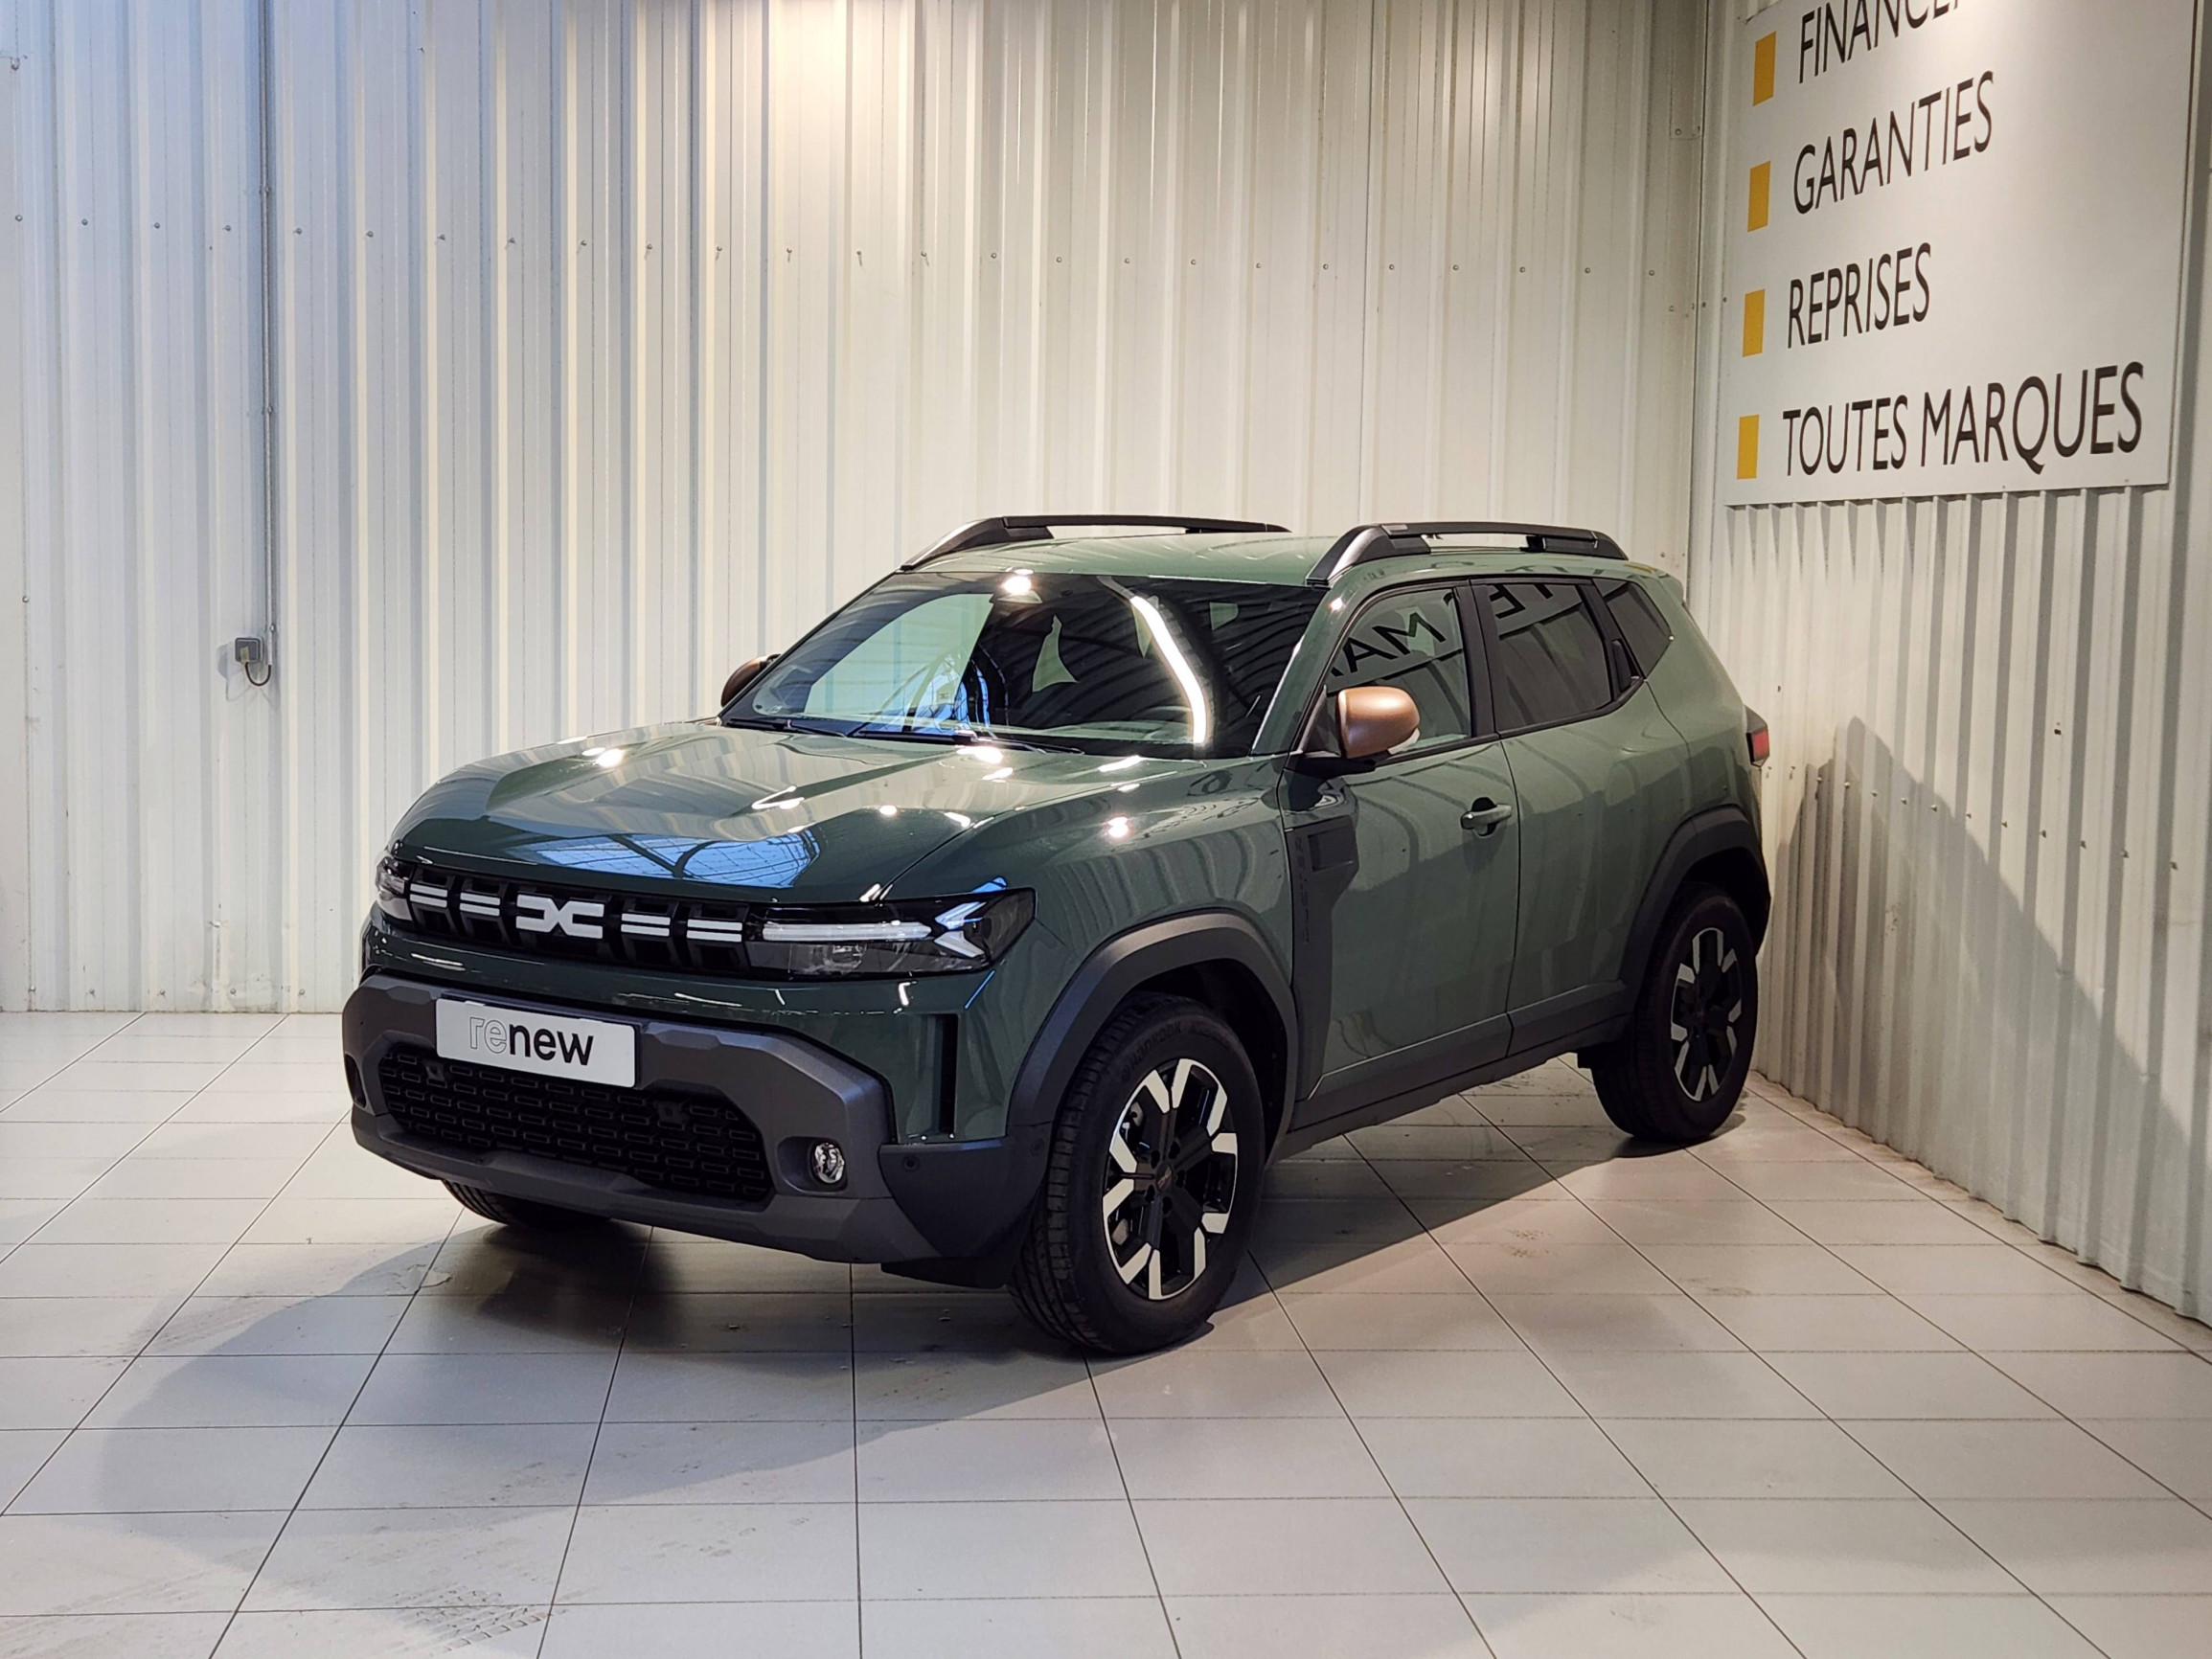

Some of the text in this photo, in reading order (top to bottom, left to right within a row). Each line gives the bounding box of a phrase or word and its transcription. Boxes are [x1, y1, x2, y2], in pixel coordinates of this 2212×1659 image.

[1793, 71, 1994, 215] GARANTIES
[1788, 242, 1931, 348] REPRISES
[1783, 361, 2144, 476] TOUTES MARQUES
[469, 1017, 594, 1066] renew
